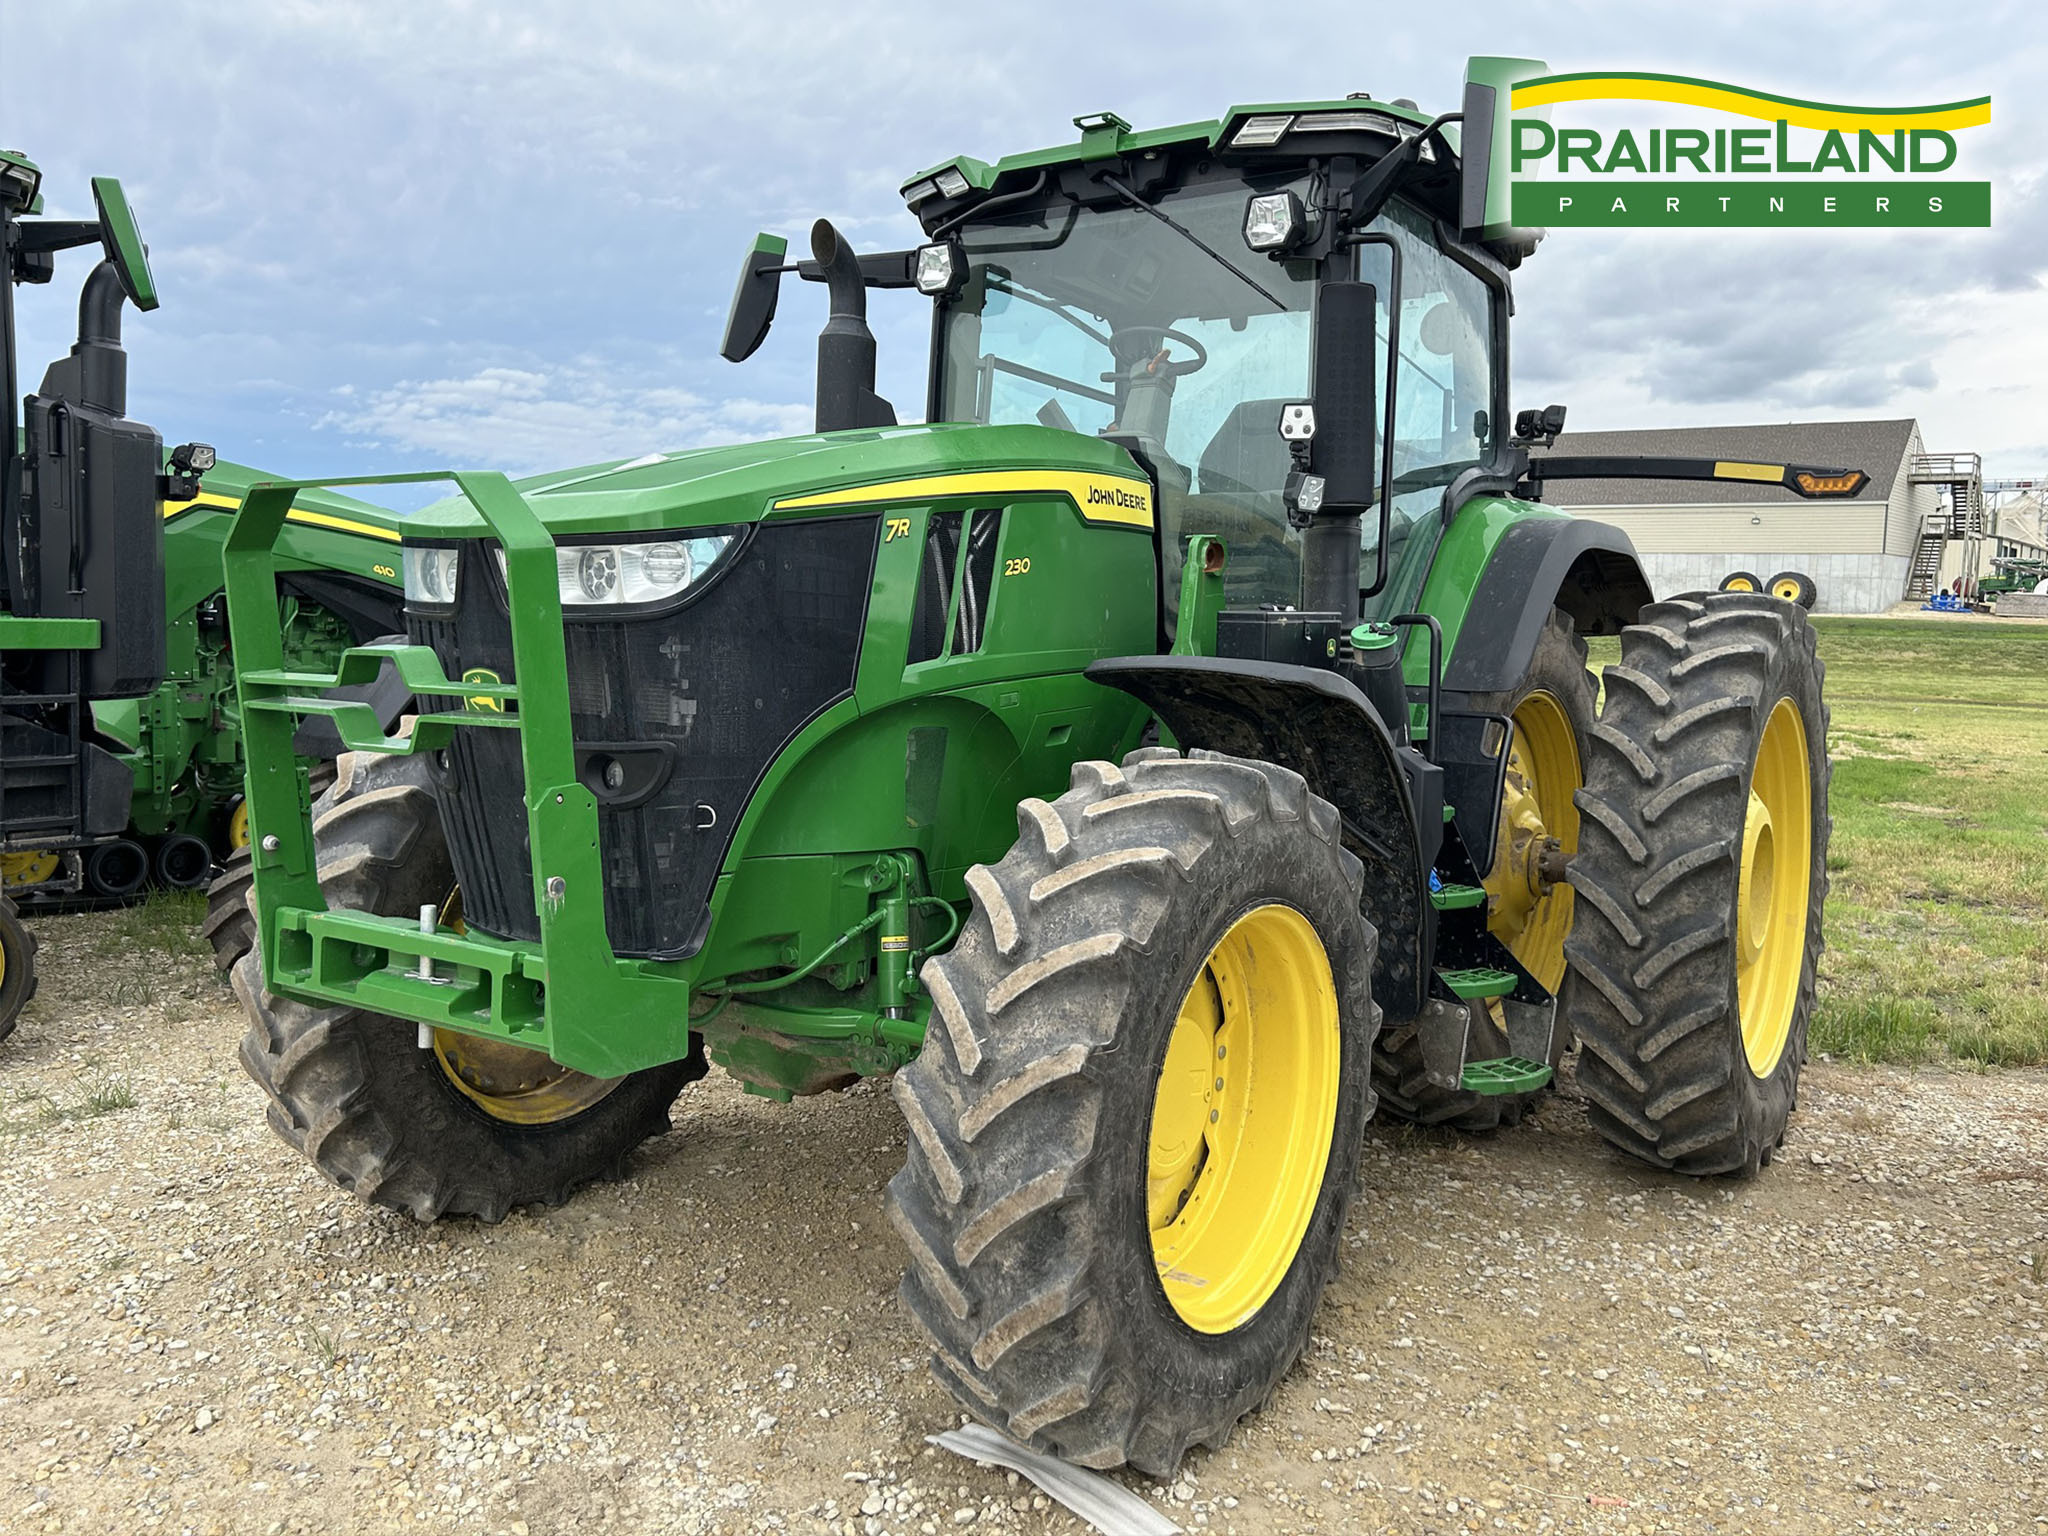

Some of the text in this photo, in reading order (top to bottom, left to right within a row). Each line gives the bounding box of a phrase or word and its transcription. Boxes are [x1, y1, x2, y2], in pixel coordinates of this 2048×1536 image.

[1087, 485, 1147, 512] JOHN DEERE
[885, 518, 911, 543] 7R
[372, 564, 396, 578] 410
[1004, 557, 1031, 577] 230
